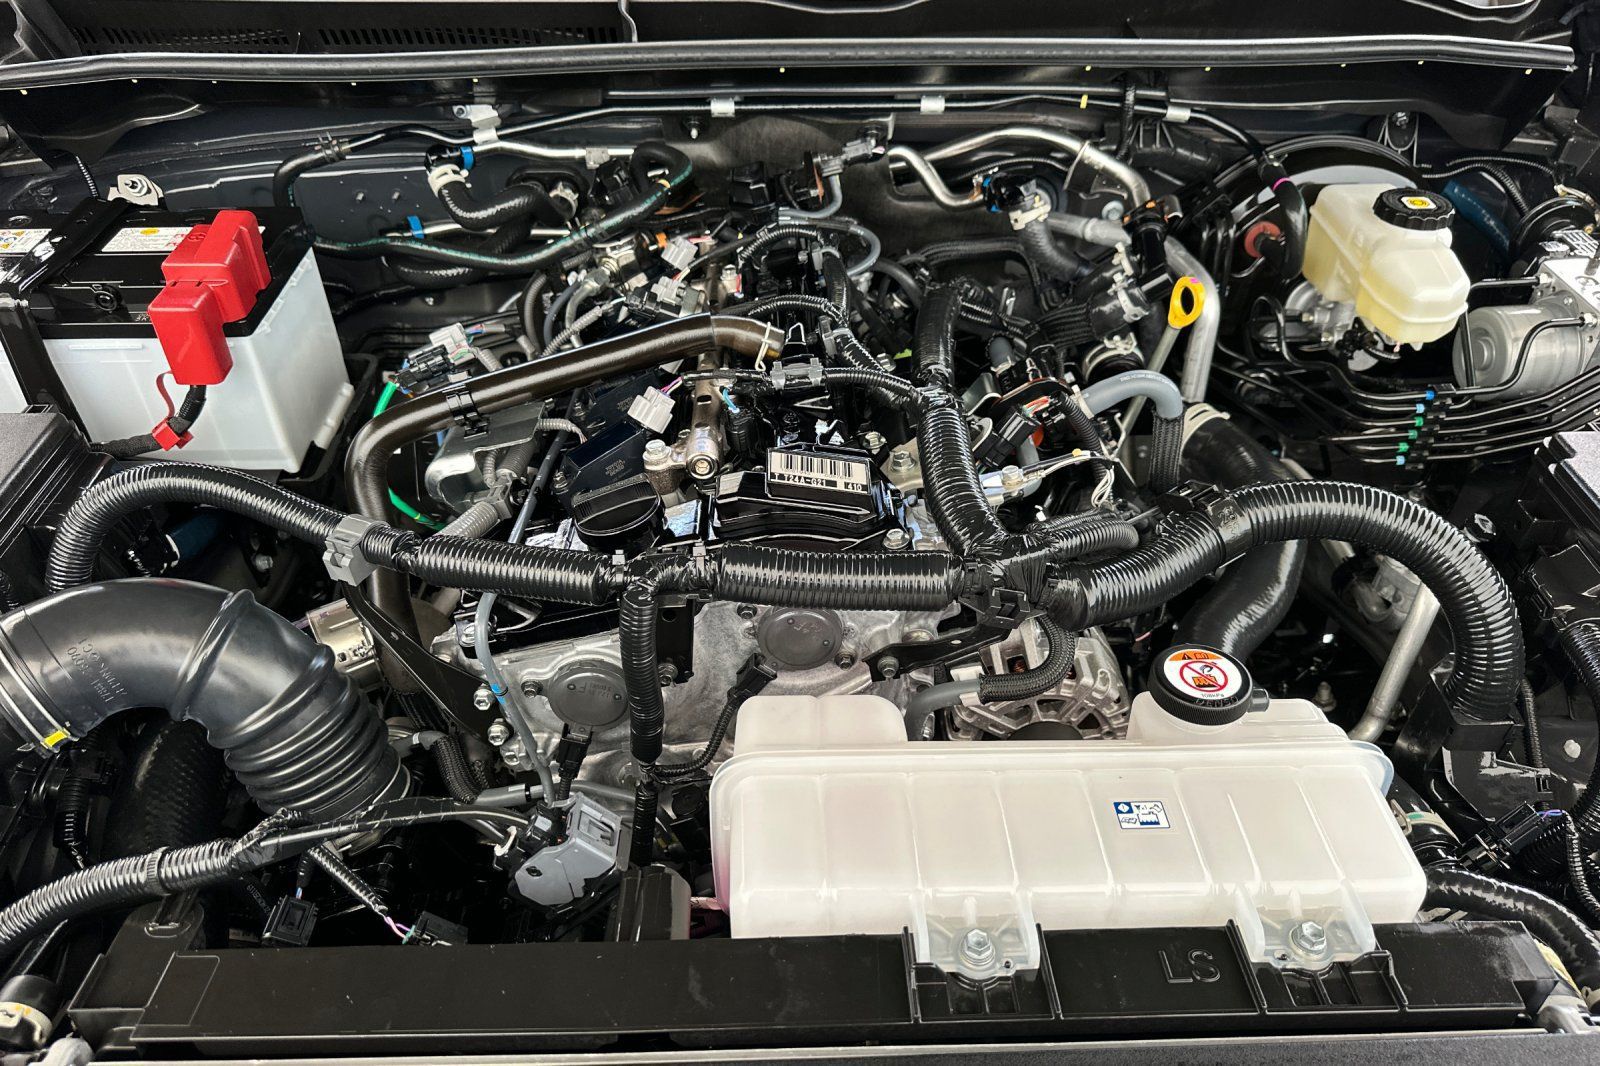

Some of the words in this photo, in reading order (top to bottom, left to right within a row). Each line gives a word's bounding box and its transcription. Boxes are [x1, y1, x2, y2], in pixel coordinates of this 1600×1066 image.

[784, 474, 826, 487] T24A-G21
[1195, 696, 1240, 708] DENSO
[1157, 949, 1221, 984] LS
